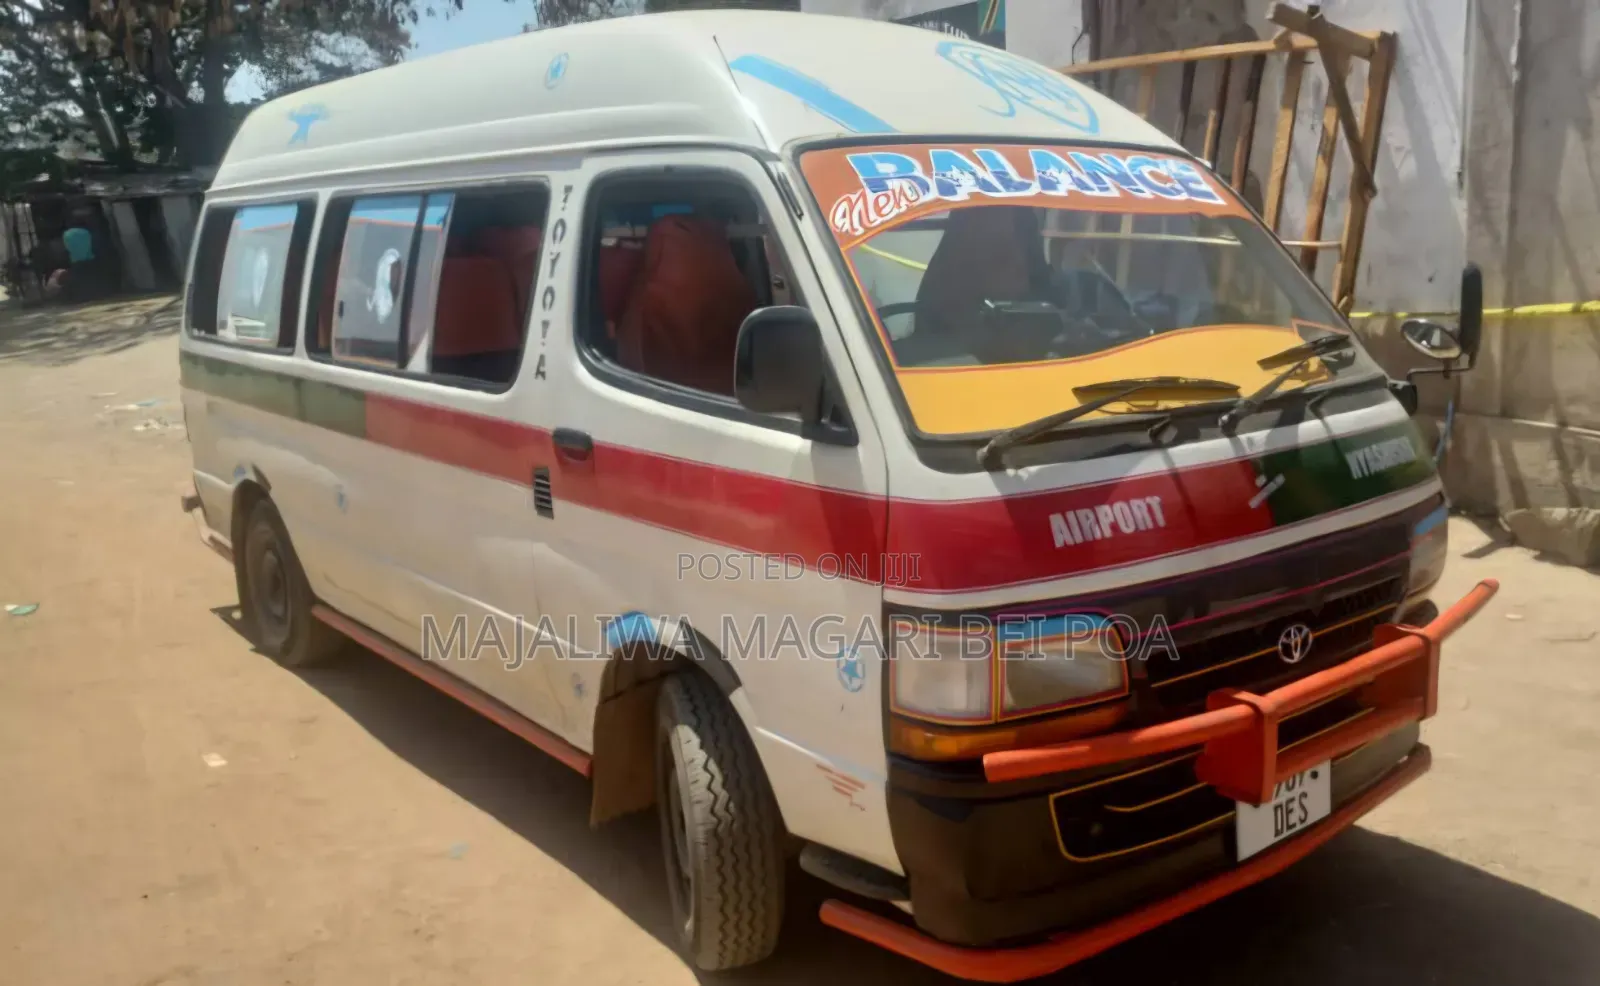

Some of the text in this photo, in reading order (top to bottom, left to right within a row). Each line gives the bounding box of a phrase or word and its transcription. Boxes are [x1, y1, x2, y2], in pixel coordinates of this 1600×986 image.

[846, 148, 1227, 205] BALANCE
[534, 185, 574, 380] TOYOTA
[1048, 495, 1166, 549] AIRPORT
[1273, 791, 1308, 838] DES
